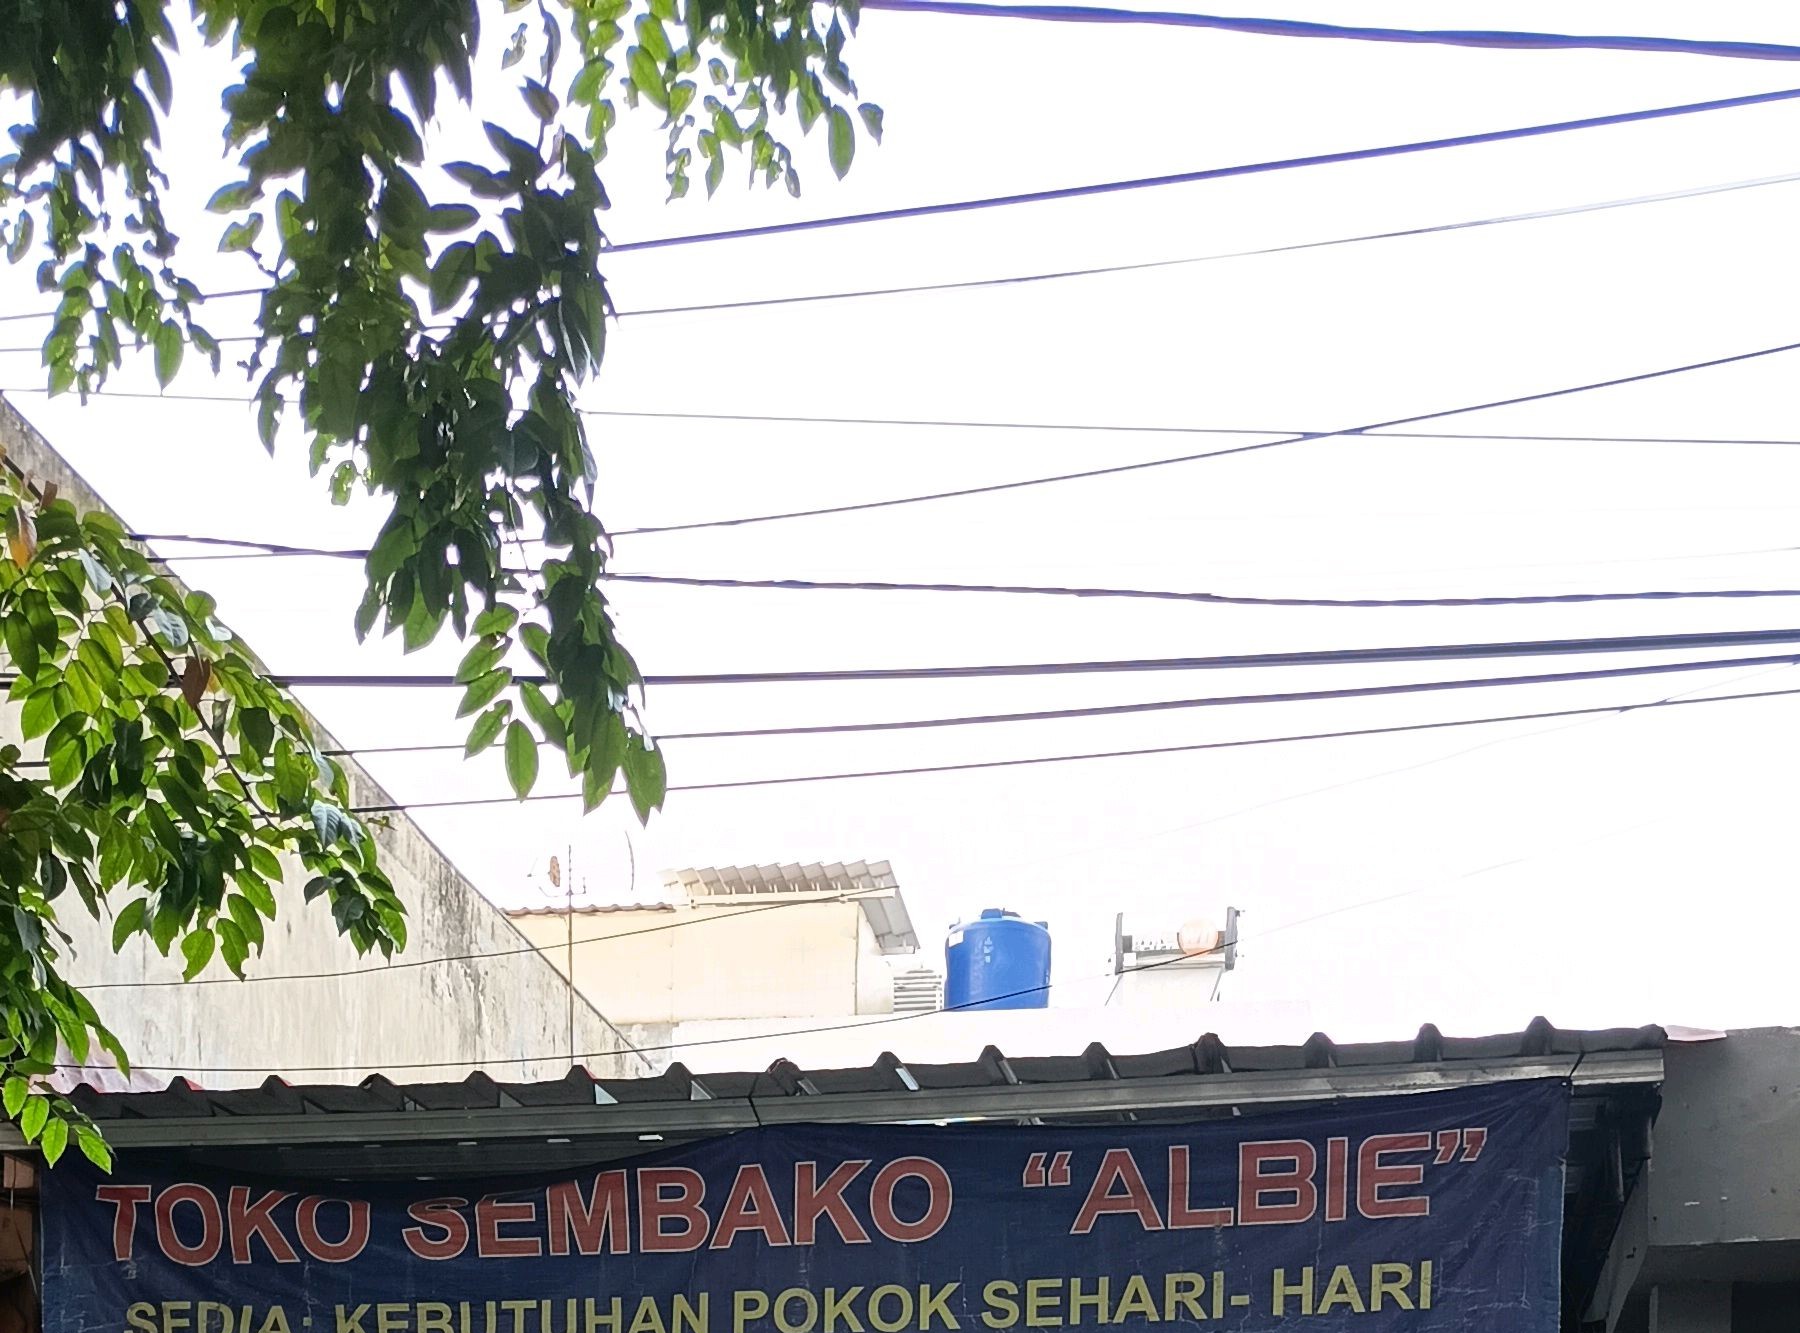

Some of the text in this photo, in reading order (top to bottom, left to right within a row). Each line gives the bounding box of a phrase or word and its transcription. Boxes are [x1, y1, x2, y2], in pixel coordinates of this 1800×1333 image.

[96, 1126, 1488, 1267] TOKO SEMBAKO “ALBIE”
[981, 1271, 1251, 1329] SEHARI-
[1272, 1259, 1433, 1317] HARI
